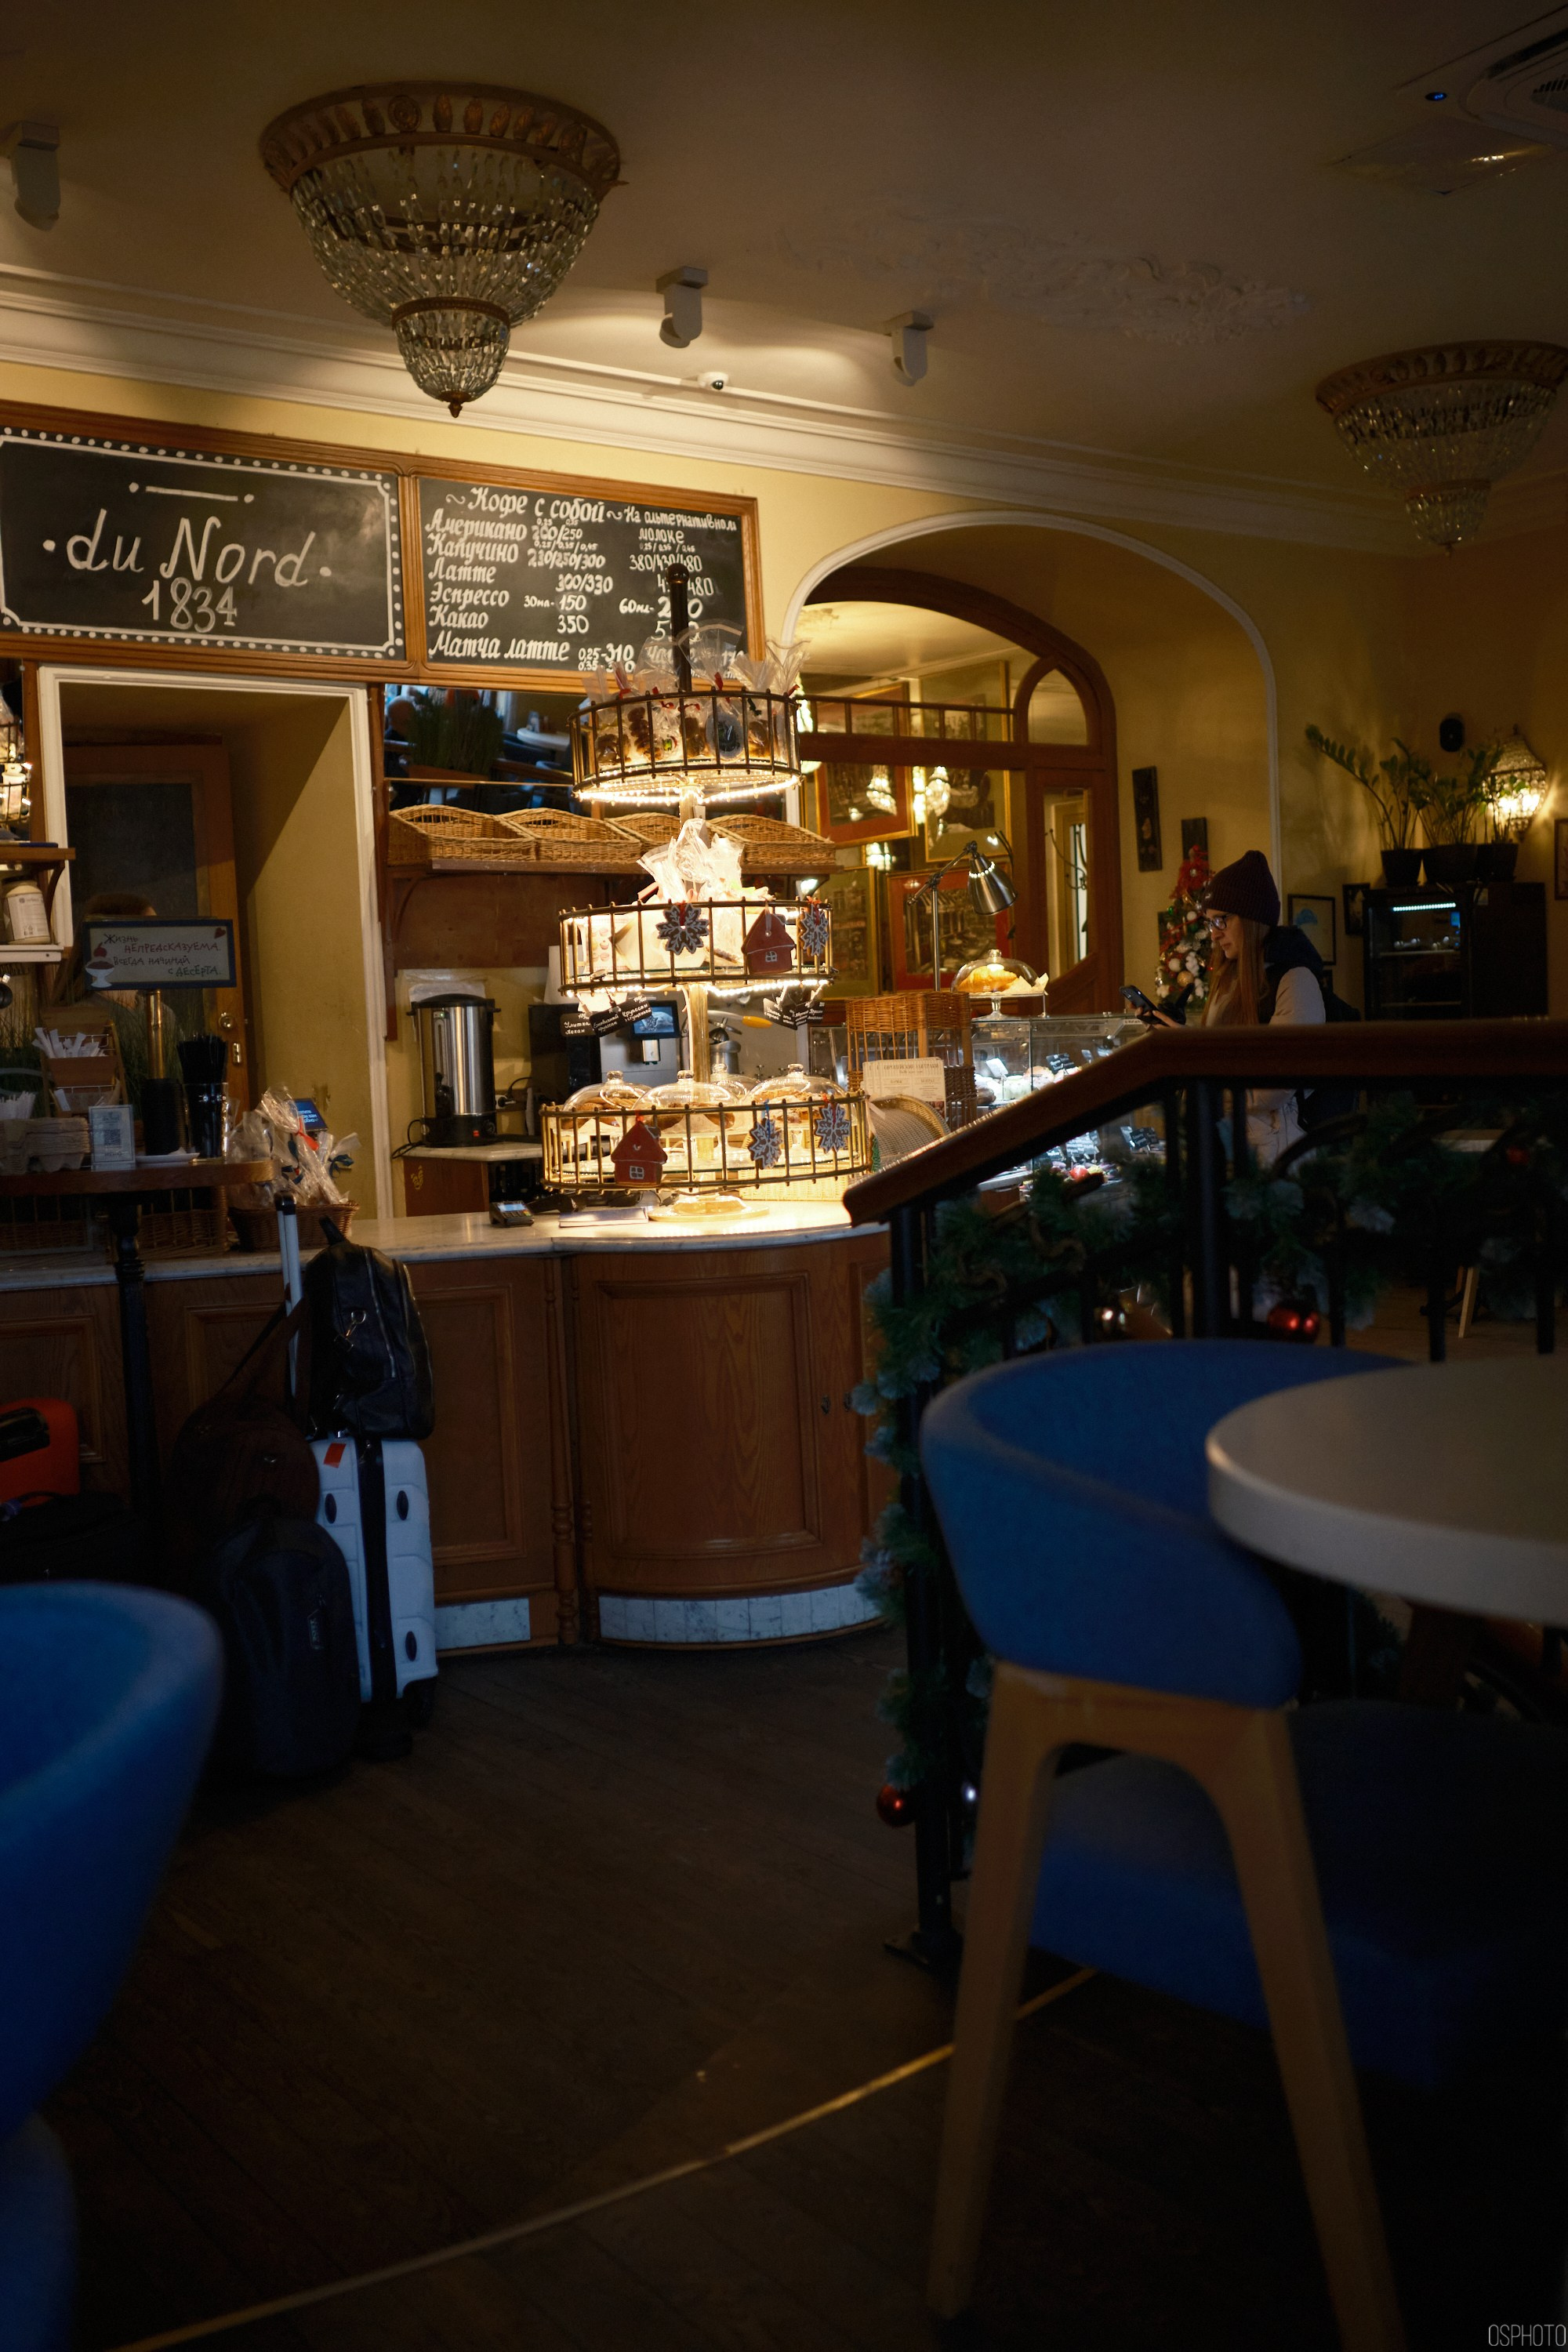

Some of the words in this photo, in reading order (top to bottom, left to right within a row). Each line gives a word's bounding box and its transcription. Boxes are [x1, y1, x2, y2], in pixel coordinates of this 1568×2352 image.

[467, 487, 528, 518] Кофе
[535, 498, 546, 517] с
[550, 498, 605, 523] собой
[624, 506, 641, 523] На
[644, 511, 737, 531] альтернативном
[425, 508, 528, 543] Американо
[638, 528, 685, 544] молоке
[67, 509, 143, 572] du
[159, 516, 315, 586] Nord
[426, 532, 519, 565] Капучино
[428, 556, 497, 583] Латте
[142, 577, 238, 633] 1834
[429, 581, 510, 611] Эспрессо
[559, 594, 586, 611] 150
[428, 604, 489, 629] Какао
[557, 614, 590, 634] 350
[428, 630, 501, 659] Матча
[503, 638, 571, 662] латте
[103, 934, 139, 945] Жизнь
